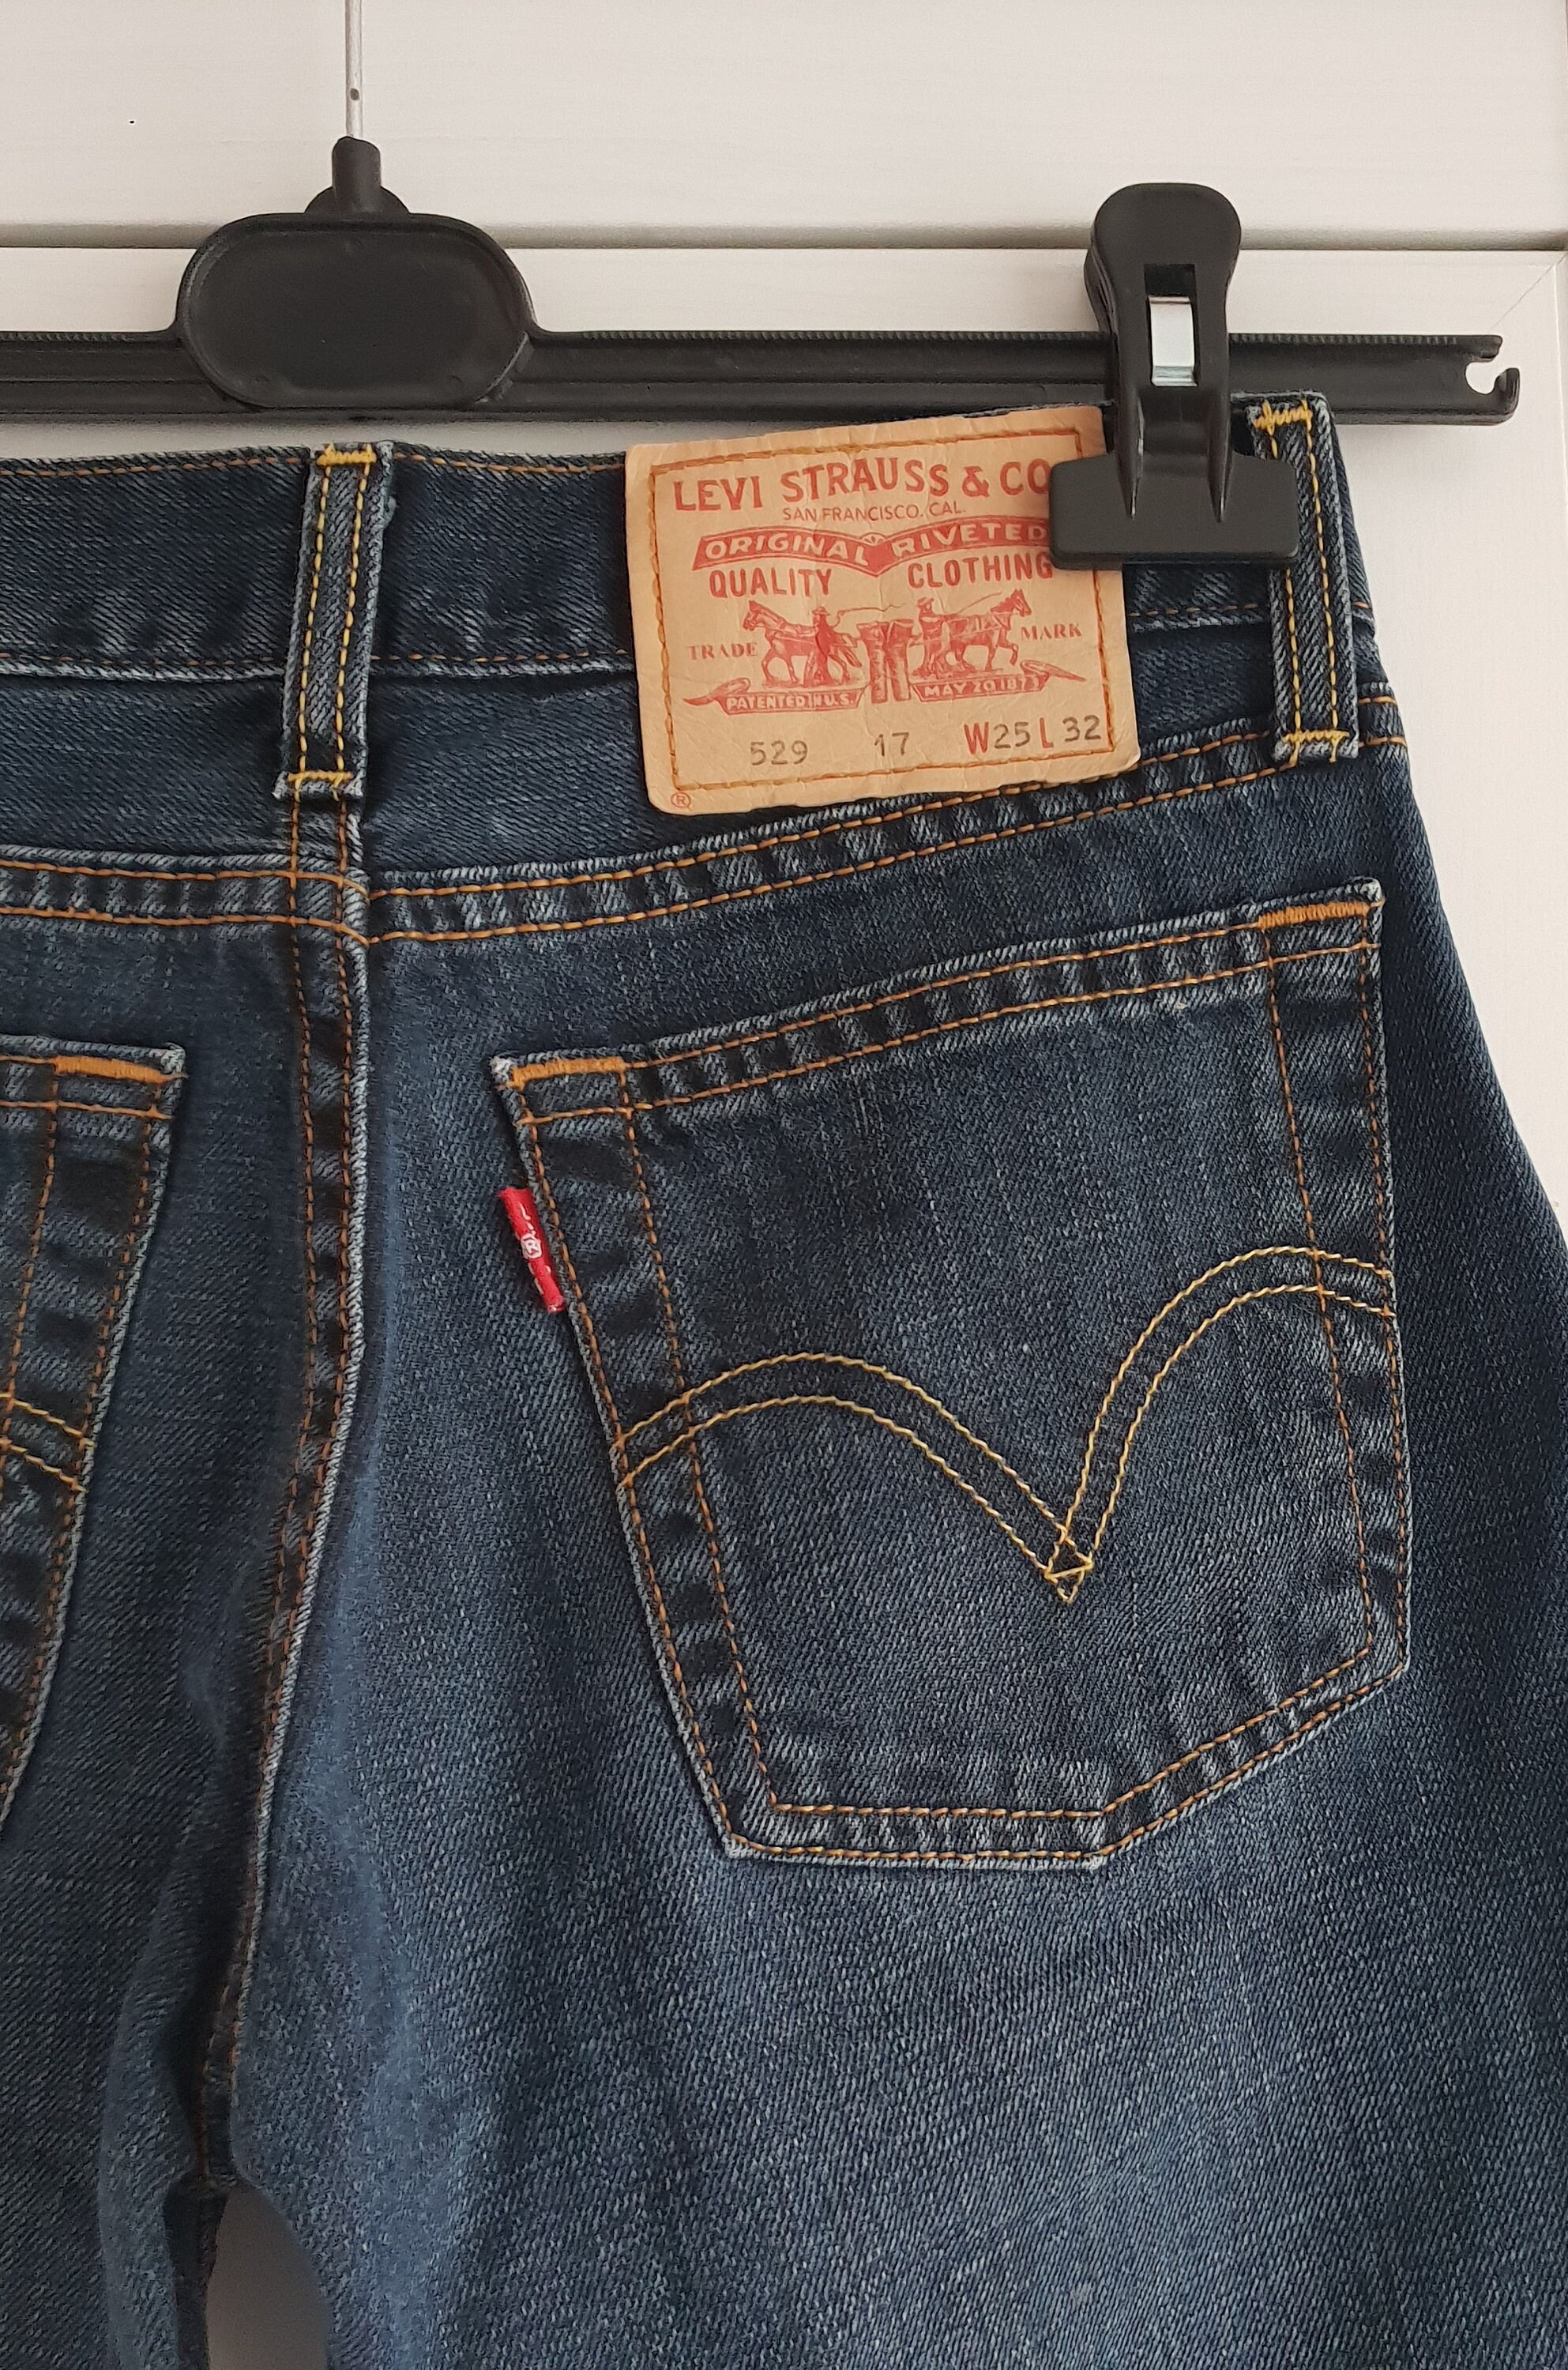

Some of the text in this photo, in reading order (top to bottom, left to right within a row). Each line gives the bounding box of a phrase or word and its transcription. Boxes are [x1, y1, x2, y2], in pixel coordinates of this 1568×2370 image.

[673, 476, 764, 511] LEVI
[780, 457, 949, 502] STRAUSS
[961, 465, 990, 498] &
[783, 507, 817, 522] SAN
[928, 501, 966, 517] CAL.
[705, 522, 1047, 567] ORIGINAL RIVETED
[709, 551, 1054, 599] QUALITY CLOTHING
[687, 622, 1082, 660] TRADE MARK
[726, 694, 805, 710] PATENTED
[924, 681, 967, 698] MAY
[750, 739, 808, 766] 529
[874, 732, 909, 756] 17
